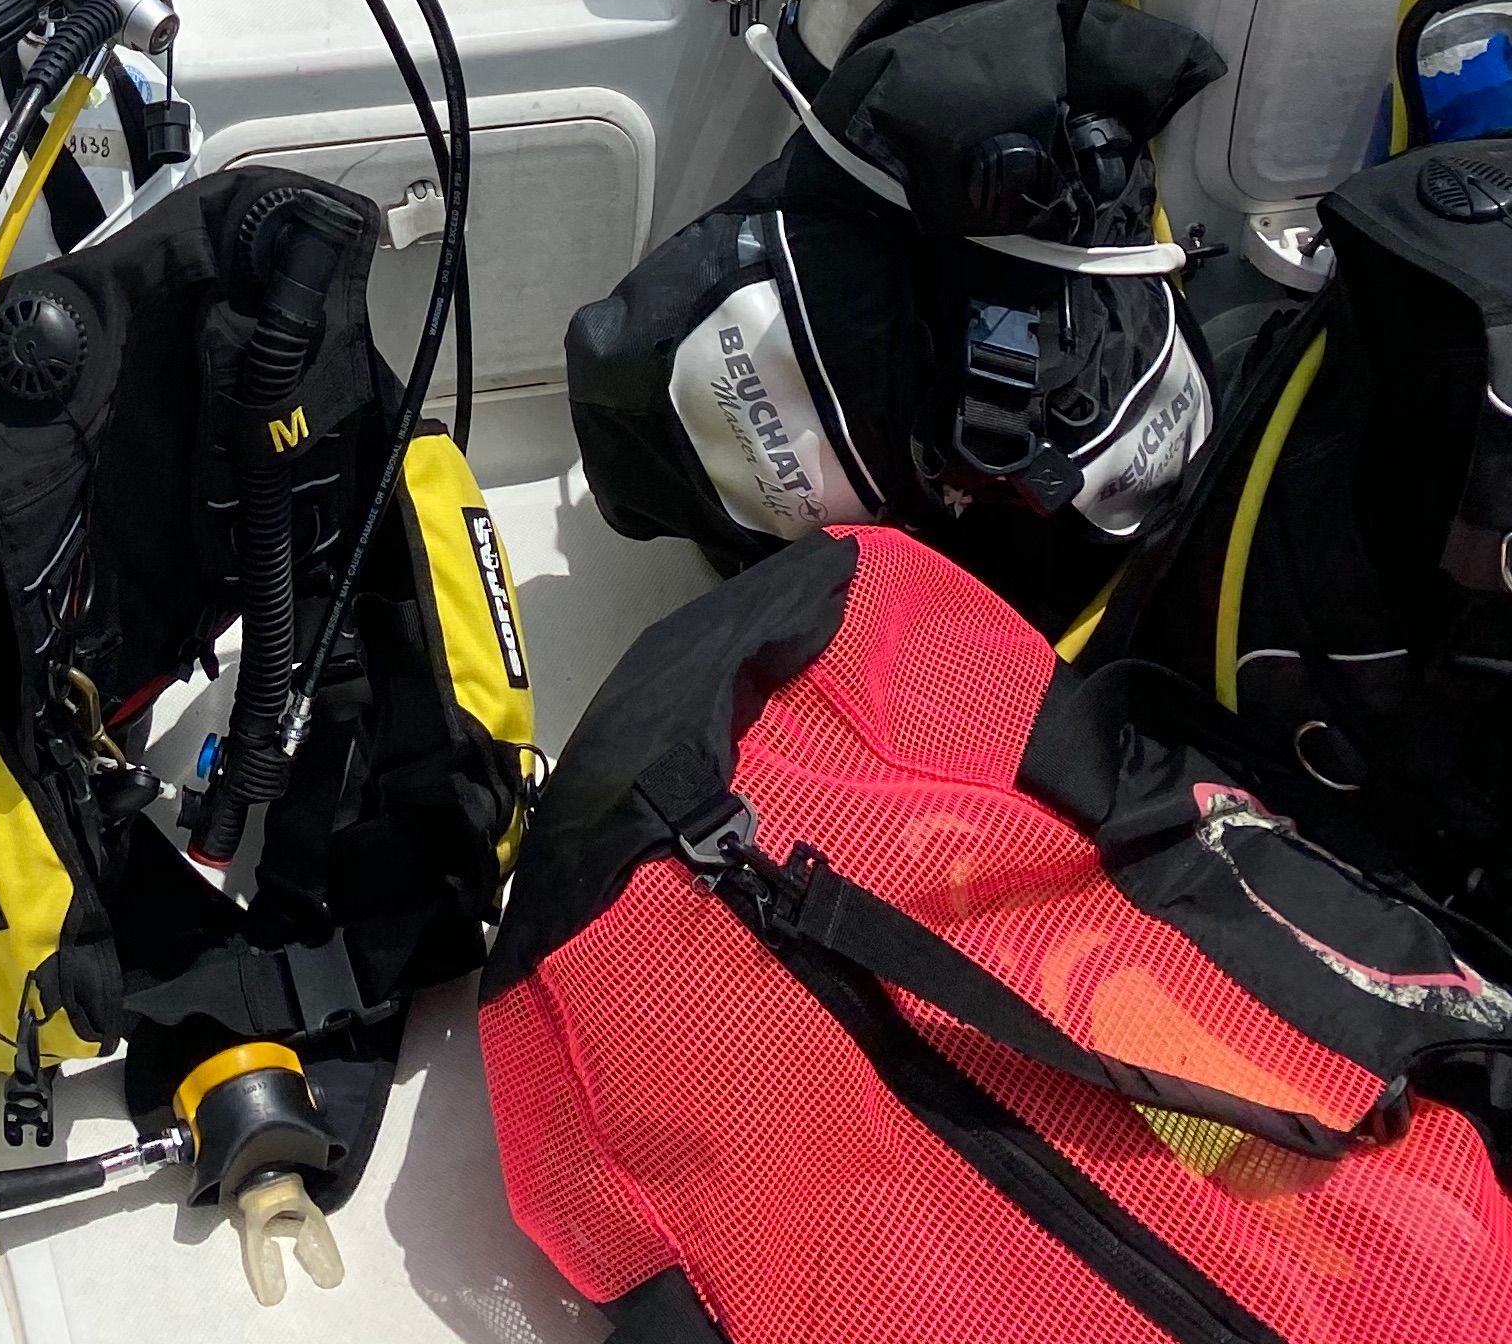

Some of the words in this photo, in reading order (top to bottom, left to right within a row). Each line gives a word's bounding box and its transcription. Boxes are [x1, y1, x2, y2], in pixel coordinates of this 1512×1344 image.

[1341, 66, 1377, 127] KOAH
[446, 248, 455, 267] NOT
[447, 209, 460, 245] EXCEED
[268, 405, 310, 453] M
[710, 375, 759, 466] Master
[719, 325, 814, 492] BEUCHAT
[347, 544, 363, 576] CAUSE
[359, 506, 379, 545] DAMAGE
[375, 487, 385, 505] OR
[381, 443, 403, 491] PERSONAL
[398, 407, 413, 441] INJURY
